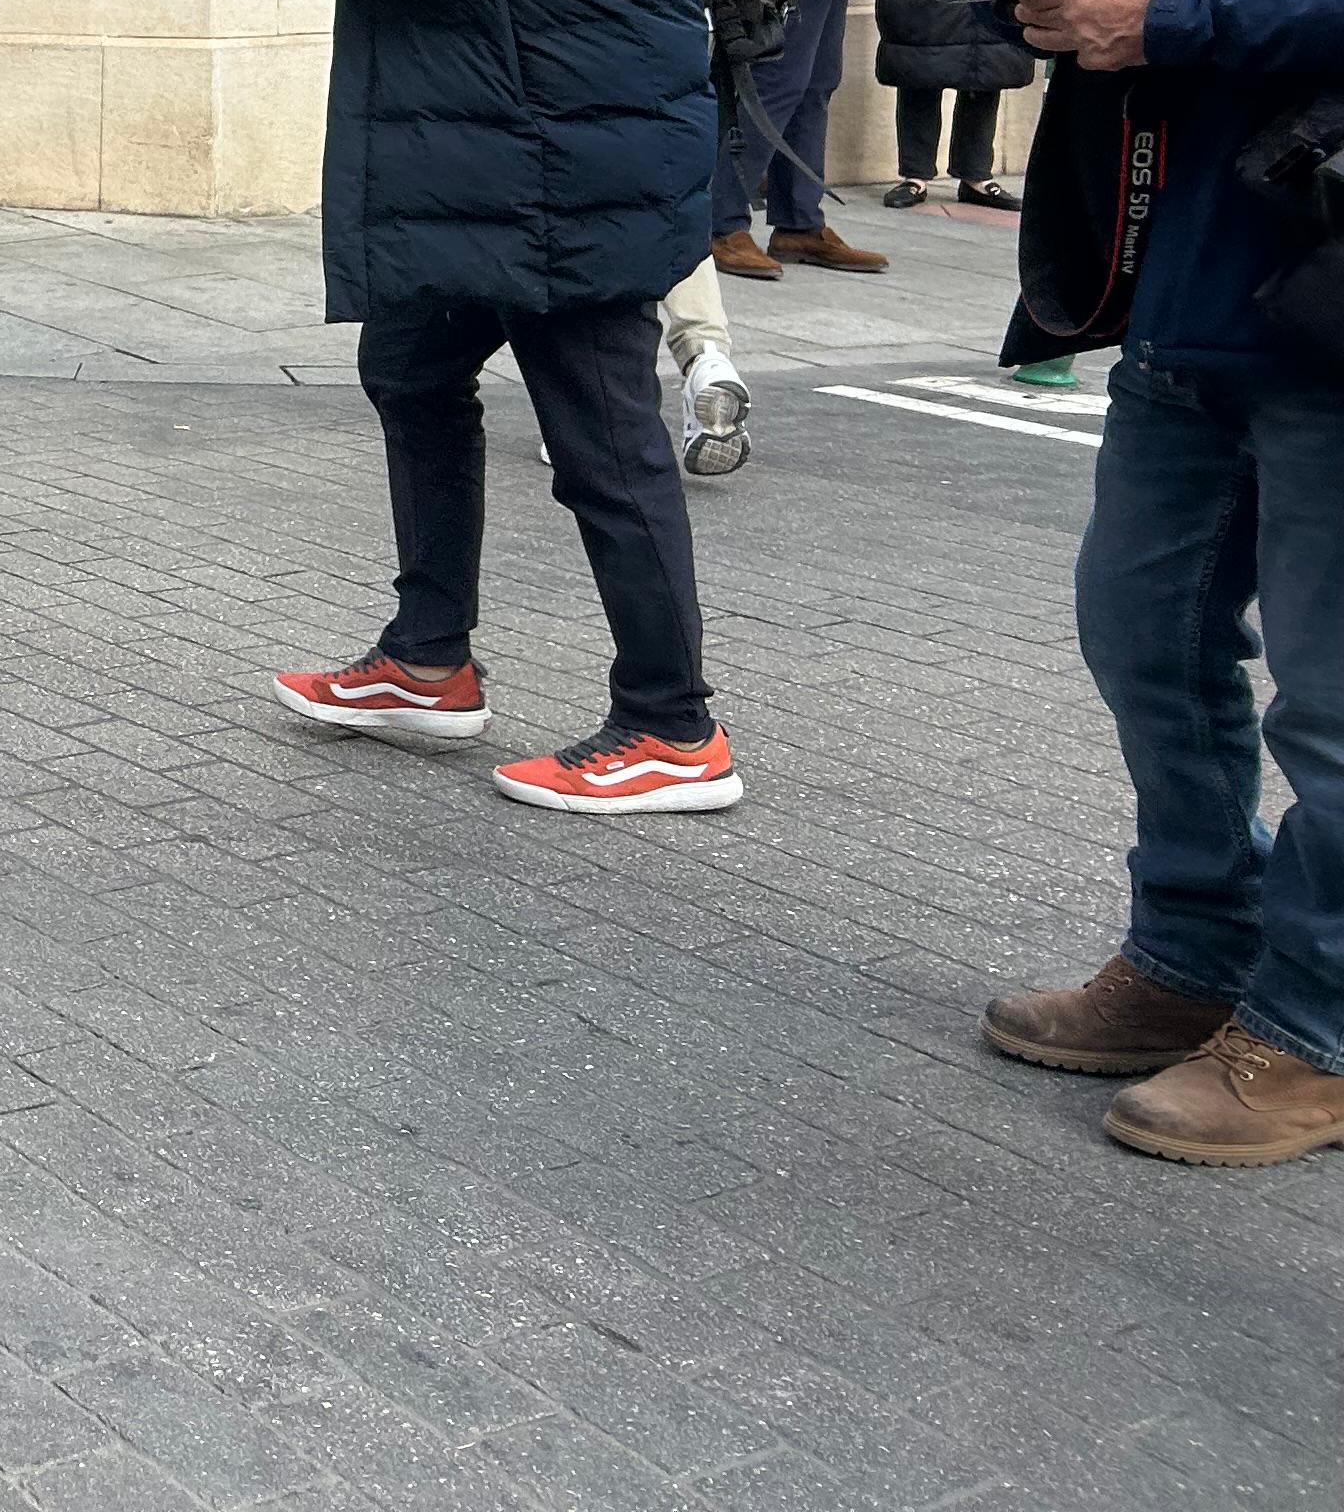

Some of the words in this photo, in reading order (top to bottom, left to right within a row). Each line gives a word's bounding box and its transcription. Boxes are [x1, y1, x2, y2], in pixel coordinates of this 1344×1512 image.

[1132, 131, 1154, 186] EOS
[1128, 192, 1150, 220] 5D
[1124, 224, 1140, 259] Mark
[1121, 260, 1136, 275] IV
